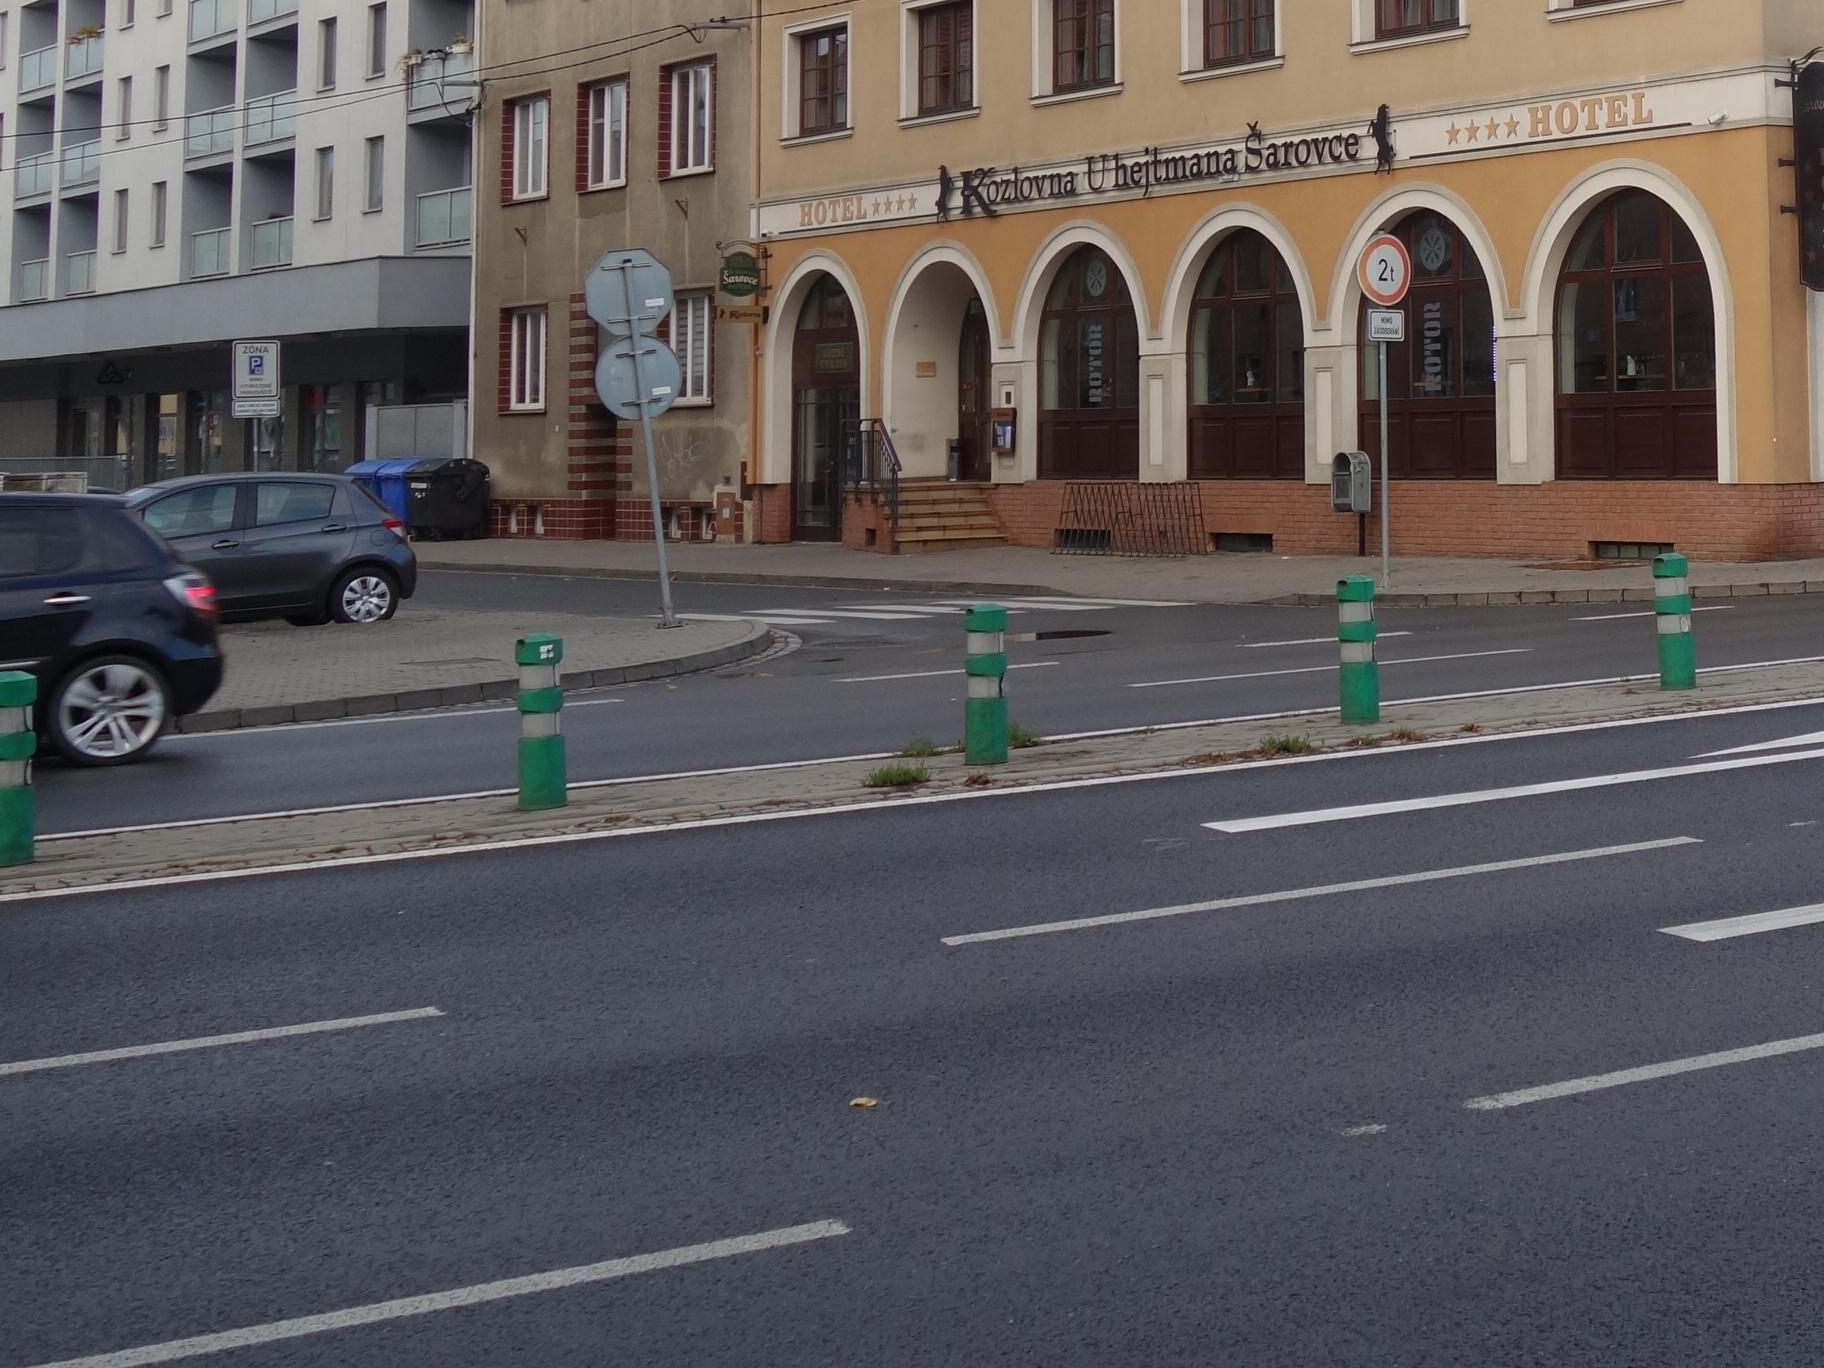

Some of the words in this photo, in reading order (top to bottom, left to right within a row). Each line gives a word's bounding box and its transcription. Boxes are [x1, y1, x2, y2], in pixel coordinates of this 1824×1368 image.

[1527, 92, 1653, 138] HOTEL
[959, 166, 1077, 217] Kozlovna
[1085, 153, 1108, 192] U
[1112, 147, 1238, 197] hejtmana
[1244, 121, 1360, 173] Šarovce
[799, 194, 868, 227] HOTEL
[1088, 324, 1102, 403] ROTOR
[1423, 301, 1442, 392] ROTOR
